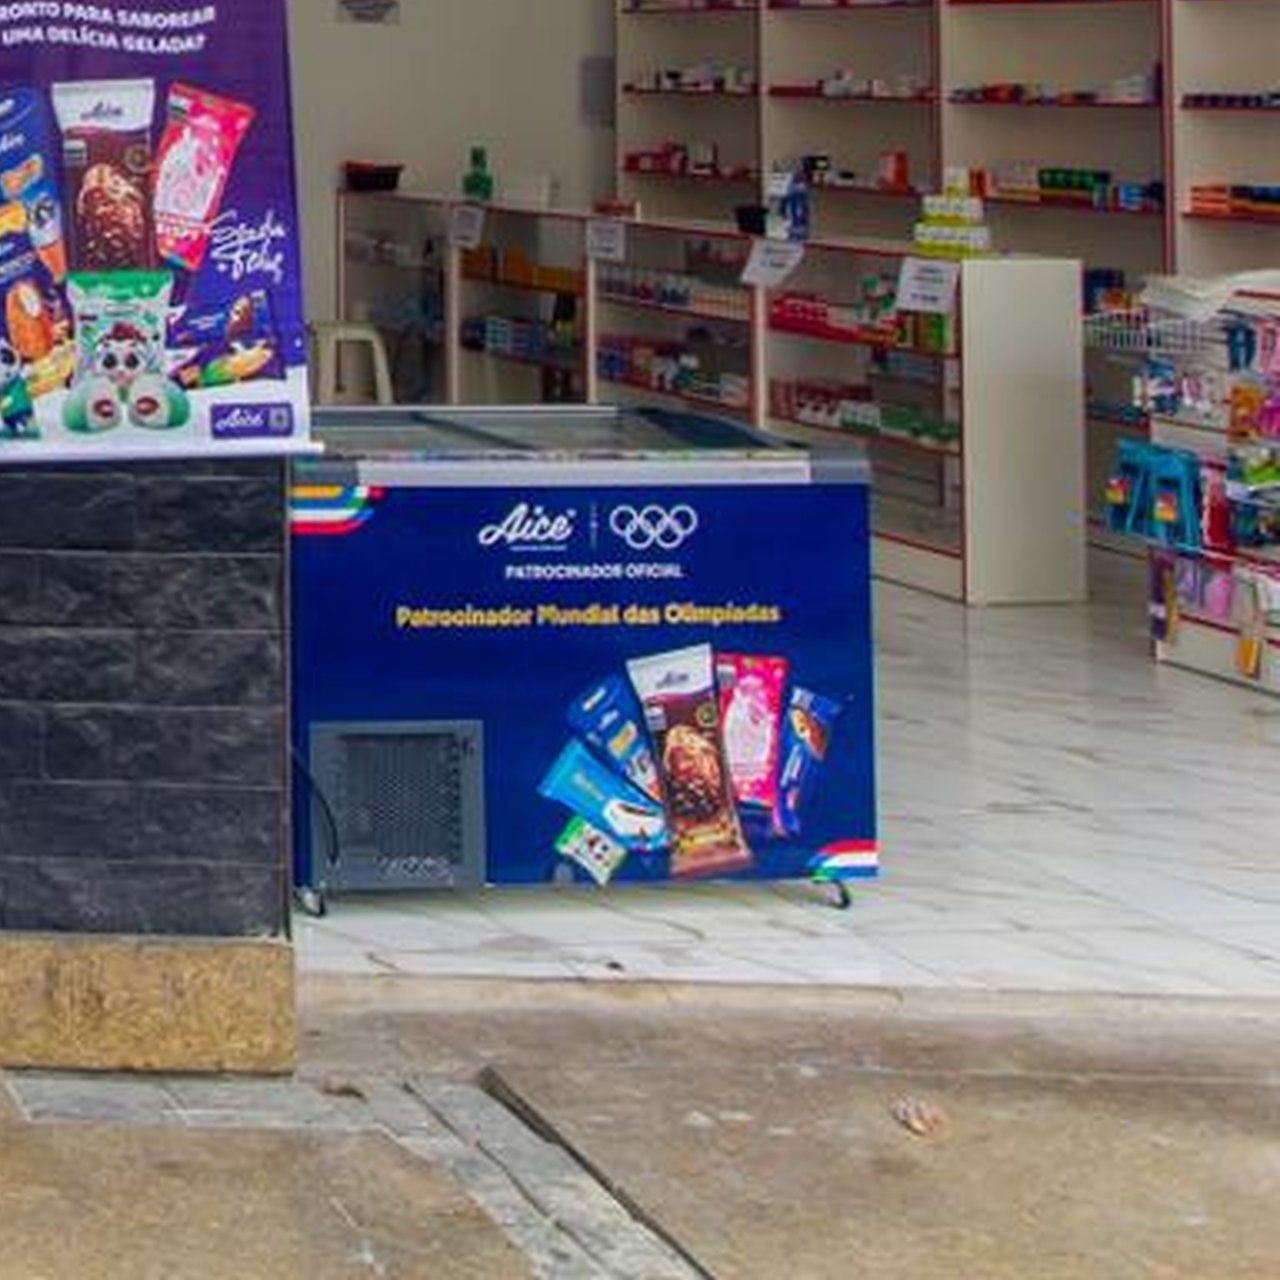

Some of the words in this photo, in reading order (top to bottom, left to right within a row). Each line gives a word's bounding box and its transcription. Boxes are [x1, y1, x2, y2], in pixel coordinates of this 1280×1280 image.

[63, 3, 114, 23] PARA
[116, 6, 216, 29] SABOREAR
[2, 26, 44, 45] UMA
[46, 25, 119, 49] DELÍCIA
[478, 502, 574, 544] Aice
[505, 563, 623, 580] PATROCINADOR
[626, 563, 683, 579] OFICIAL
[396, 604, 533, 628] Patrocinador
[537, 604, 619, 625] Mundial
[623, 604, 660, 624] das
